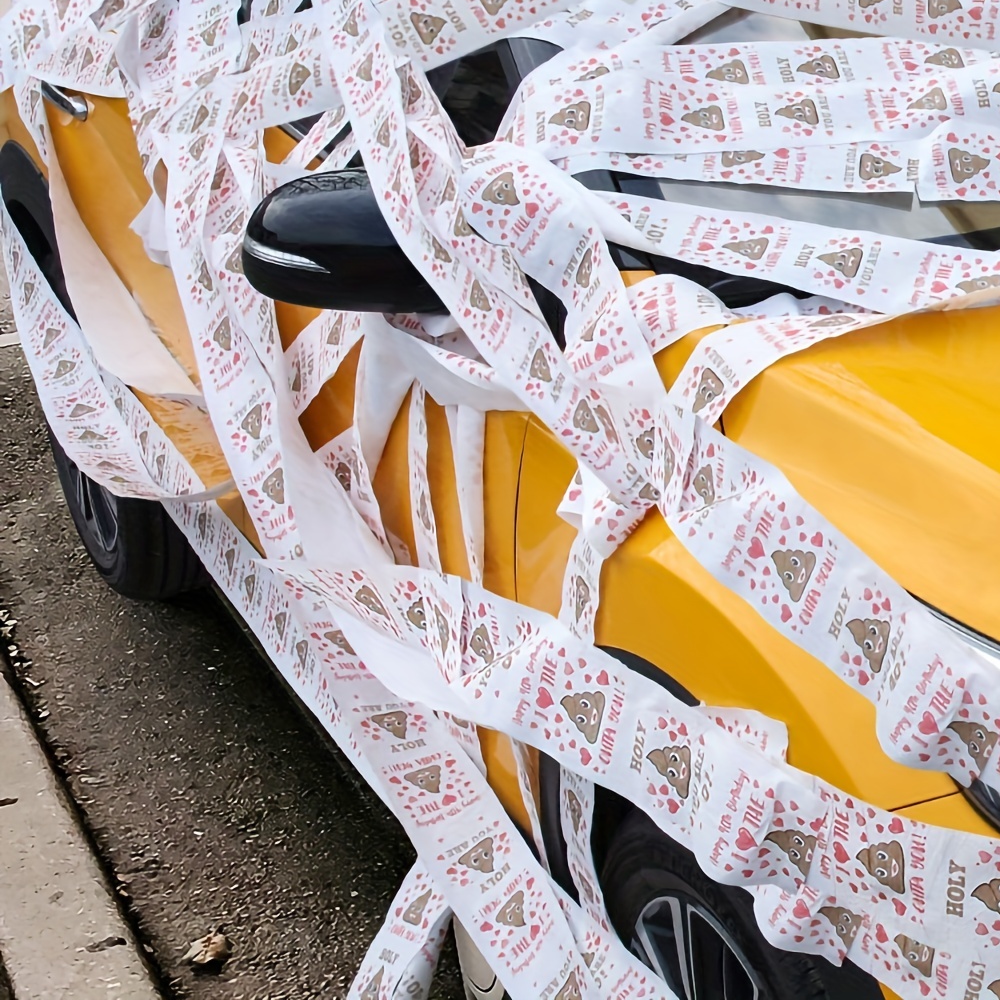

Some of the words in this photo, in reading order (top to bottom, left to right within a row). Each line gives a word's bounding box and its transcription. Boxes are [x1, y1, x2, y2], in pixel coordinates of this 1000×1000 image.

[442, 0, 467, 33] HOLY
[776, 57, 796, 84] HOLY
[658, 90, 674, 112] THE
[972, 78, 991, 109] HOLY
[536, 110, 546, 144] HOLY
[754, 101, 772, 128] HOLY
[575, 234, 591, 254] YOU
[794, 243, 816, 269] HOLY
[859, 265, 875, 288] YOU
[755, 509, 776, 539] THE
[828, 587, 851, 640] HOLY
[540, 653, 558, 687] THE
[929, 680, 955, 715] THE
[390, 738, 427, 754] HOLY
[630, 719, 648, 774] HOLY
[415, 801, 441, 815] THE
[742, 792, 766, 829] THE
[833, 808, 850, 842] THE
[946, 859, 966, 918] HOLY
[511, 936, 532, 958] THE
